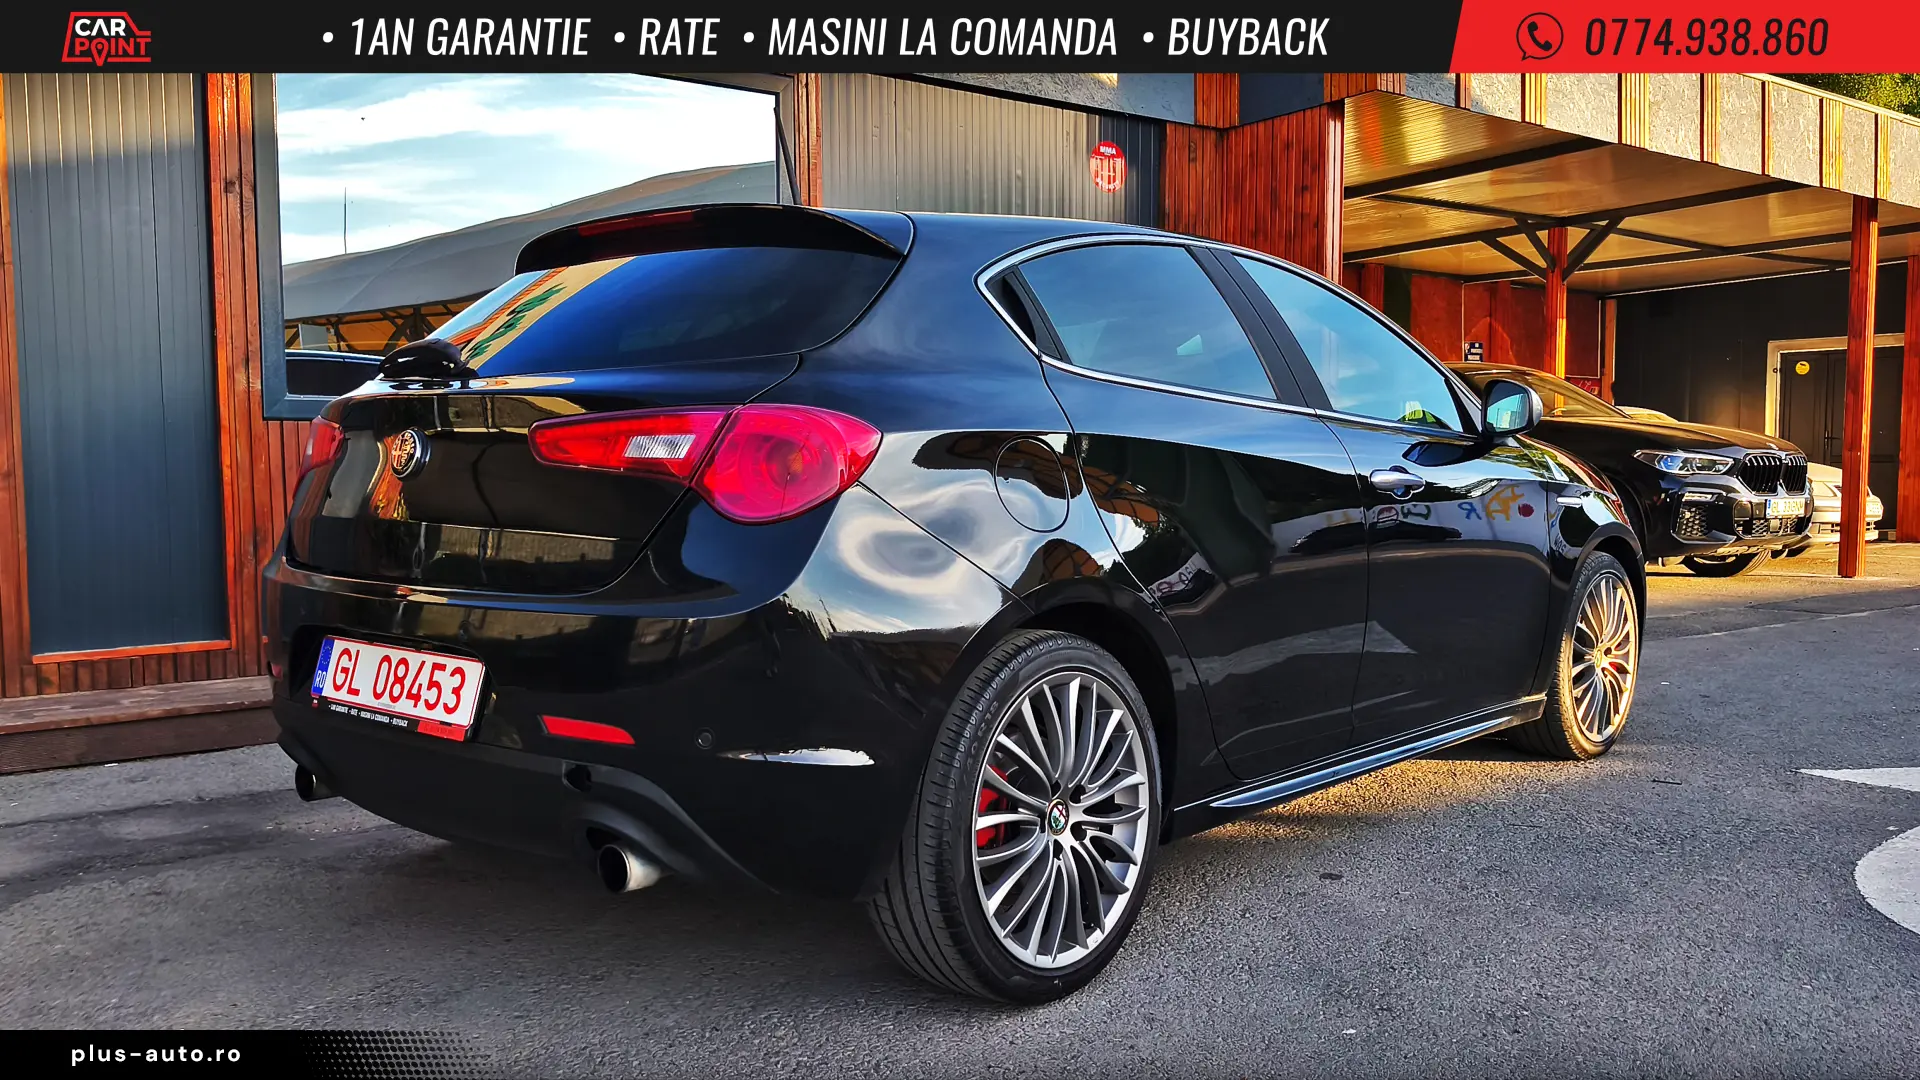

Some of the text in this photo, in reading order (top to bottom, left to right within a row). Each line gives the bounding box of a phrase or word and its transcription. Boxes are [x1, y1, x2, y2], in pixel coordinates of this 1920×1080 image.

[314, 669, 327, 688] RO
[332, 647, 466, 715] GL 08453
